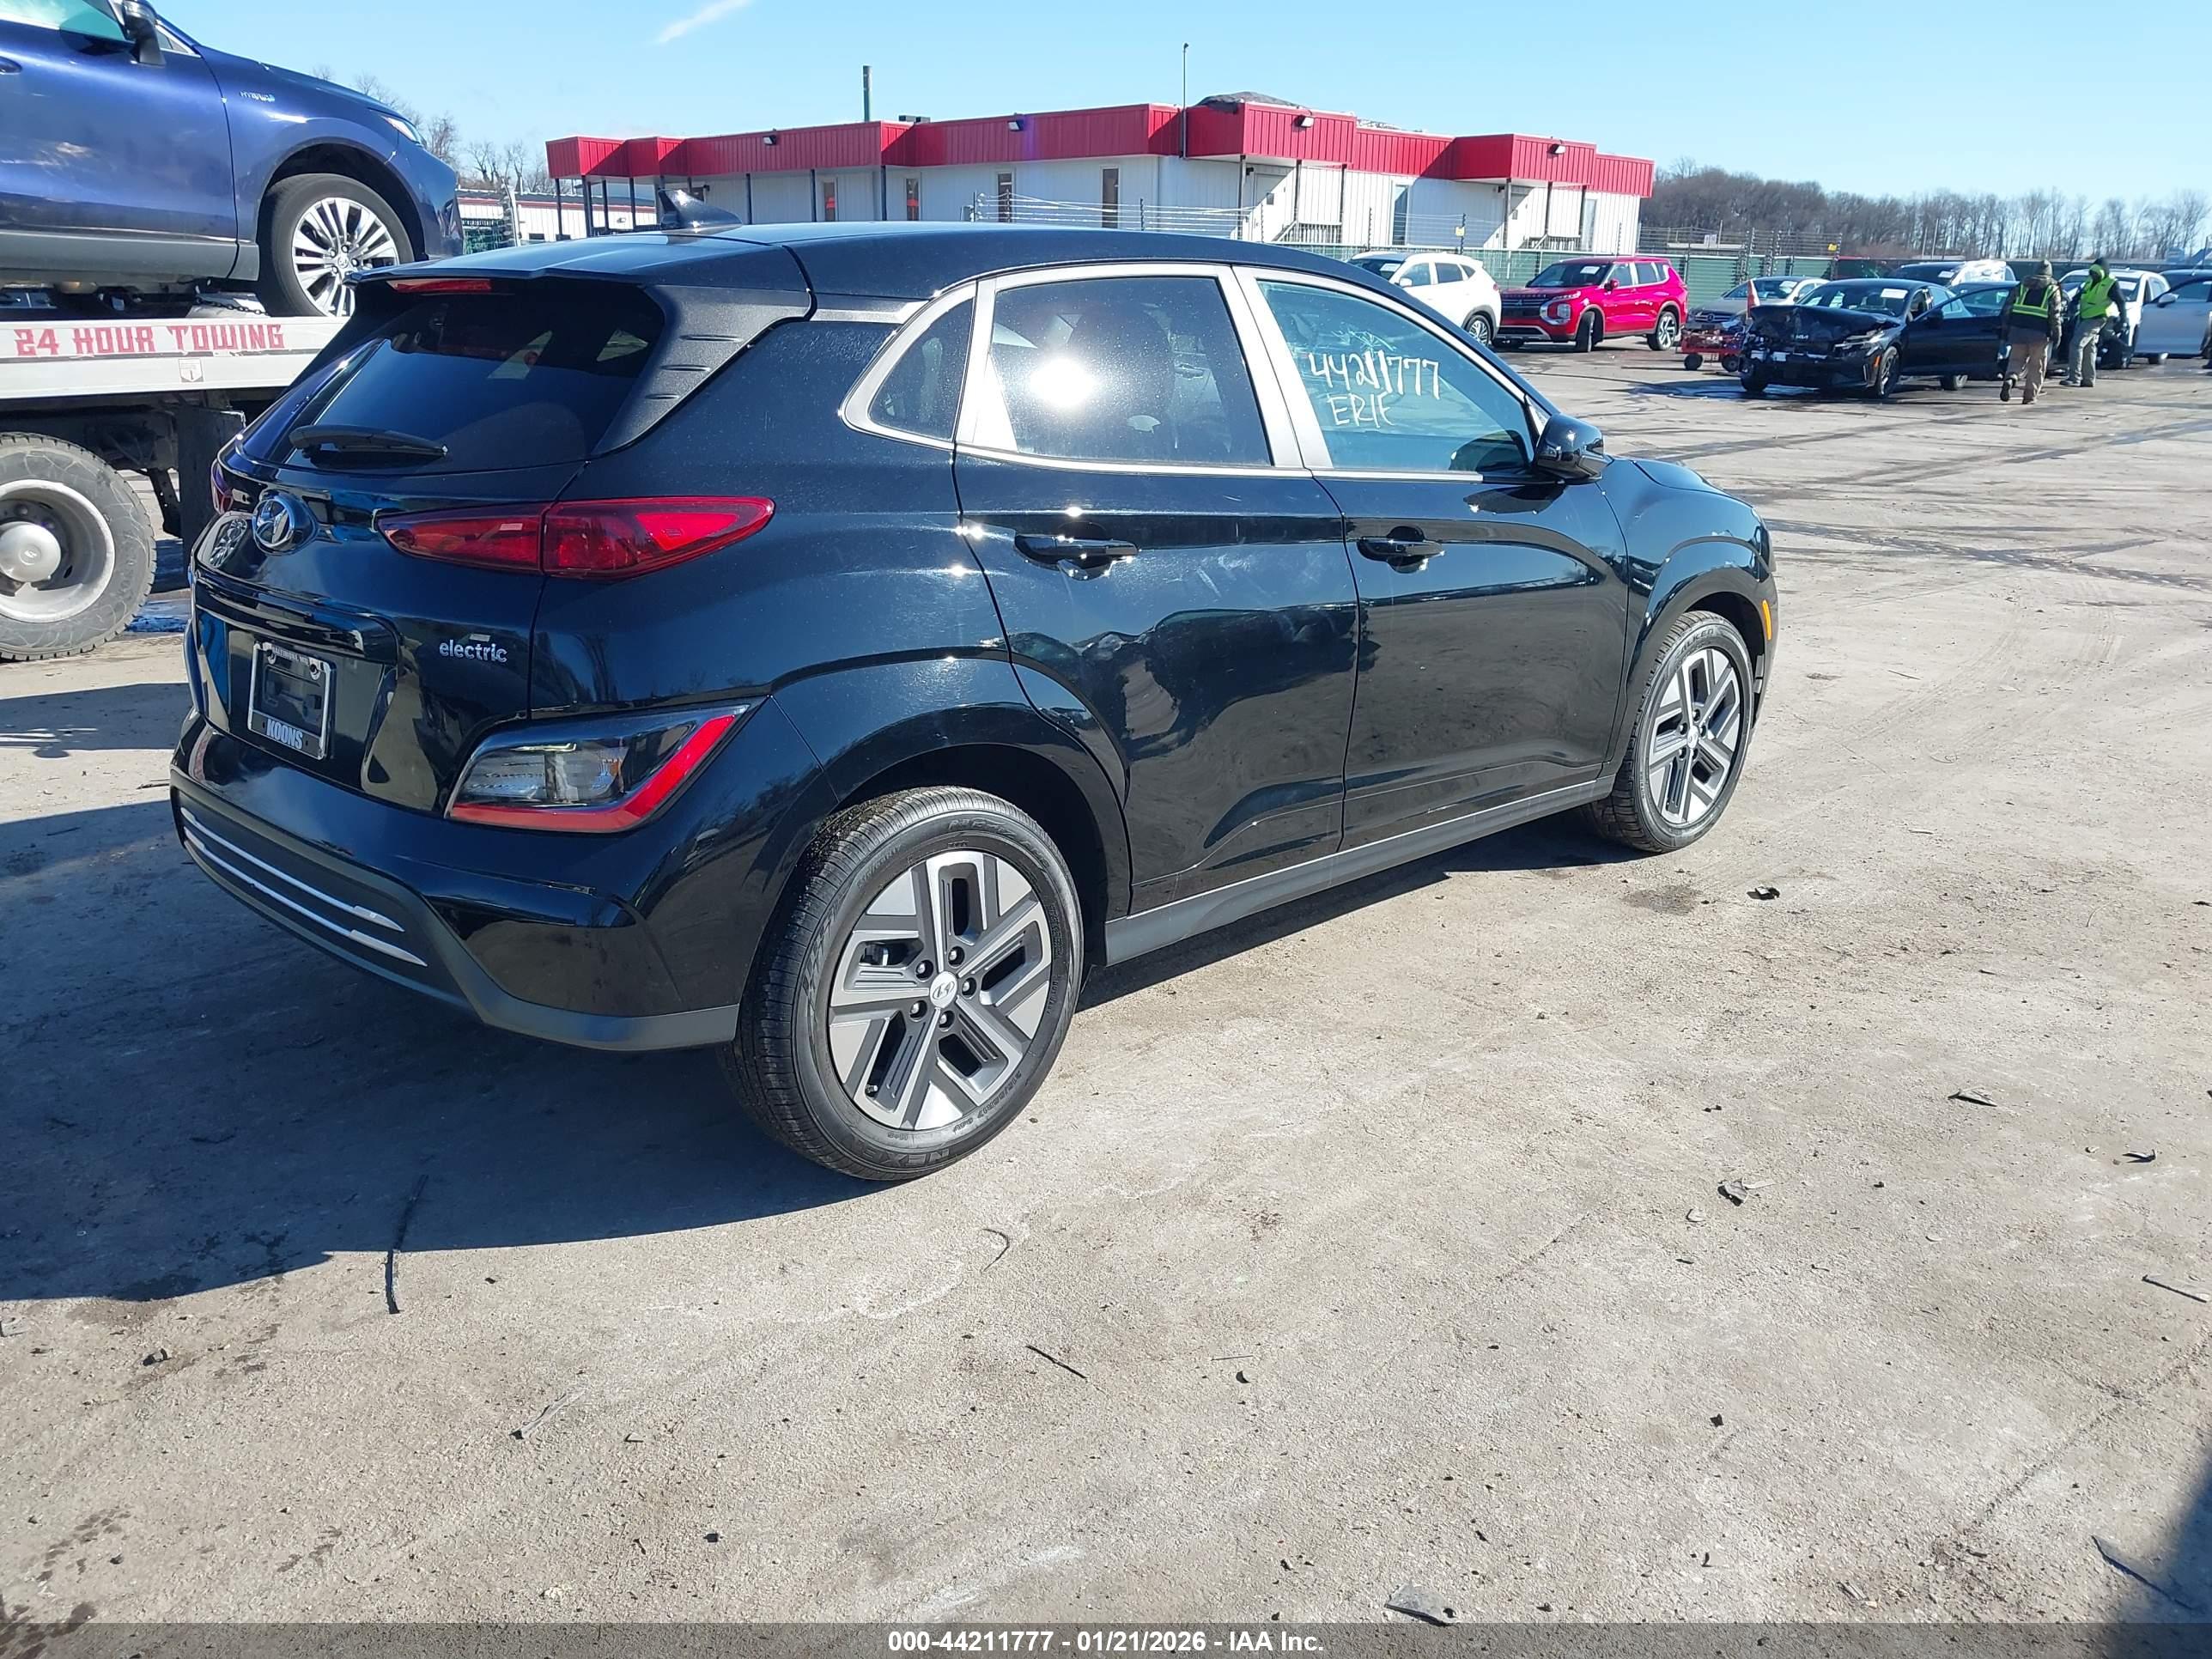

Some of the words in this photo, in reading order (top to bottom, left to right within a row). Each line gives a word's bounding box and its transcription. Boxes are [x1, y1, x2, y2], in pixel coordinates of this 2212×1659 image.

[14, 328, 59, 356] 24
[72, 325, 156, 355] HOUR
[166, 324, 285, 352] TOWING
[1308, 349, 1441, 400] 44211777
[439, 639, 508, 662] electric
[266, 719, 303, 750] KOONS
